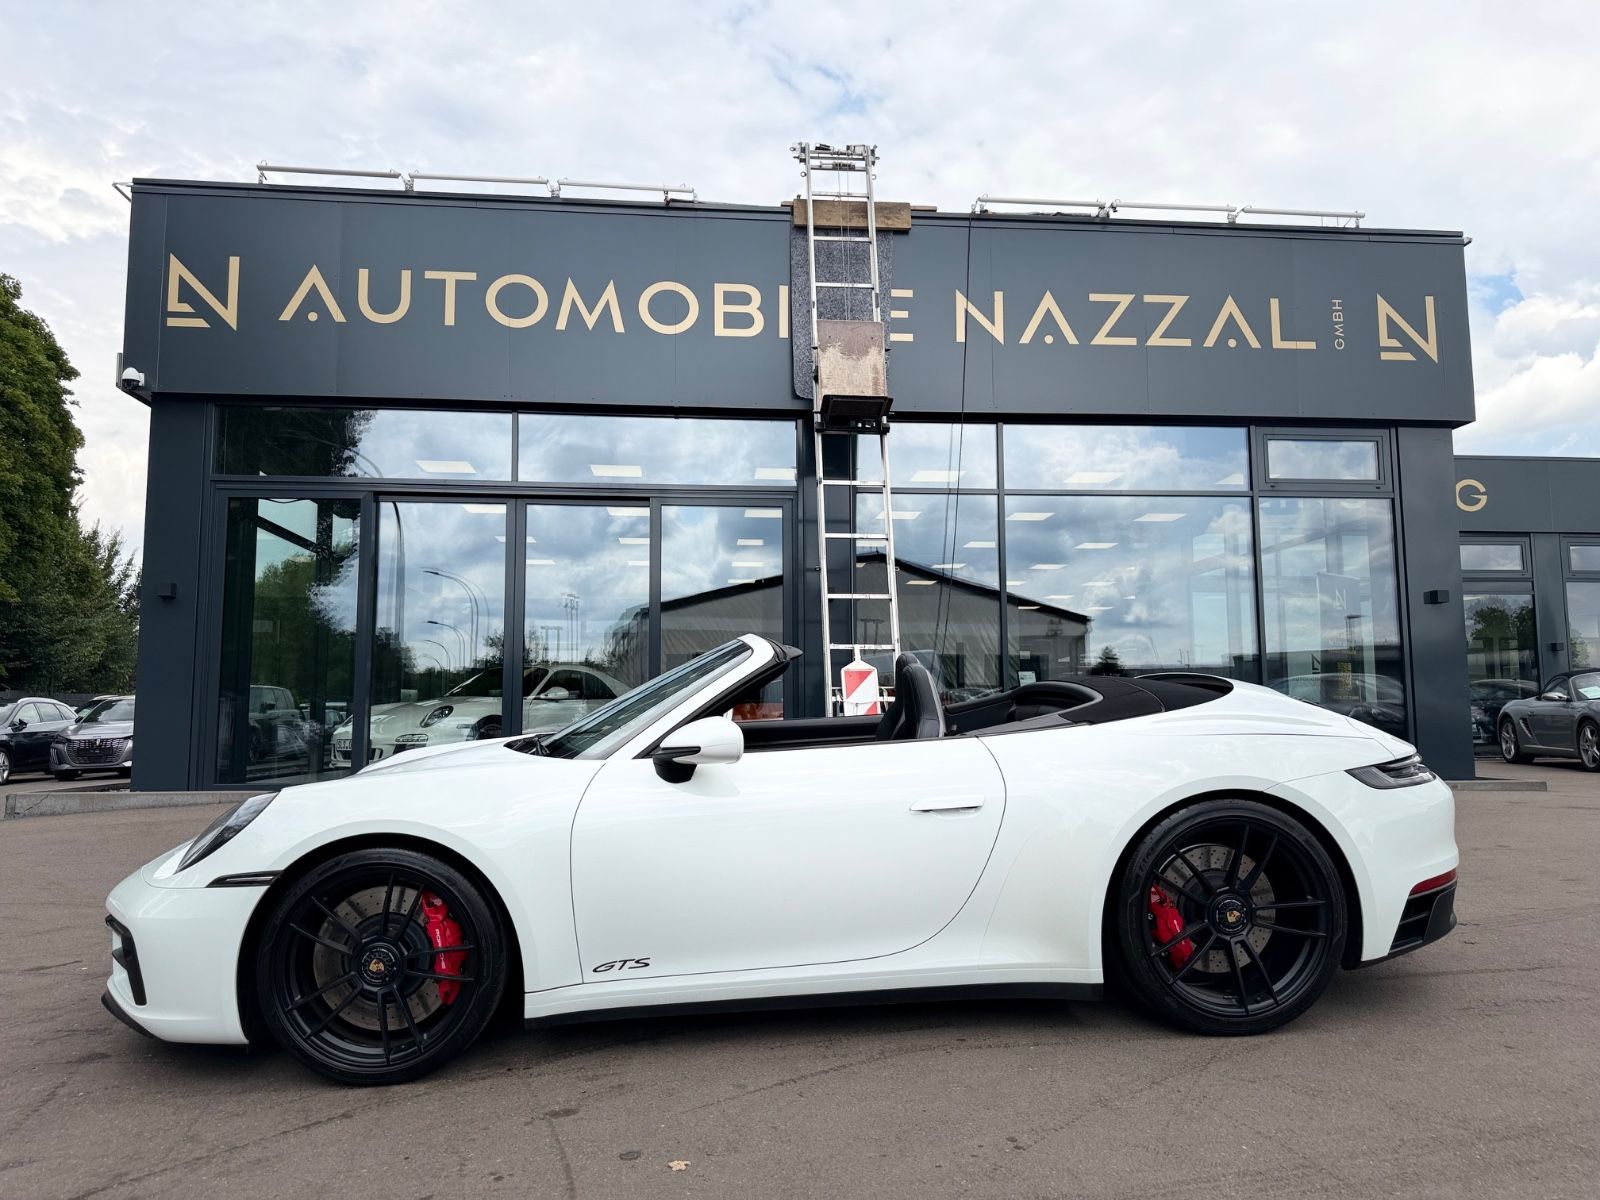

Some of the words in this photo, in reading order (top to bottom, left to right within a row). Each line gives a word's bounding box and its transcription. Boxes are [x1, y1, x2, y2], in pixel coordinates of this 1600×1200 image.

[278, 264, 914, 343] AUTOMOBIE
[954, 289, 1317, 350] NAZZAL
[1331, 299, 1345, 350] GMBH
[592, 957, 651, 973] GTS
